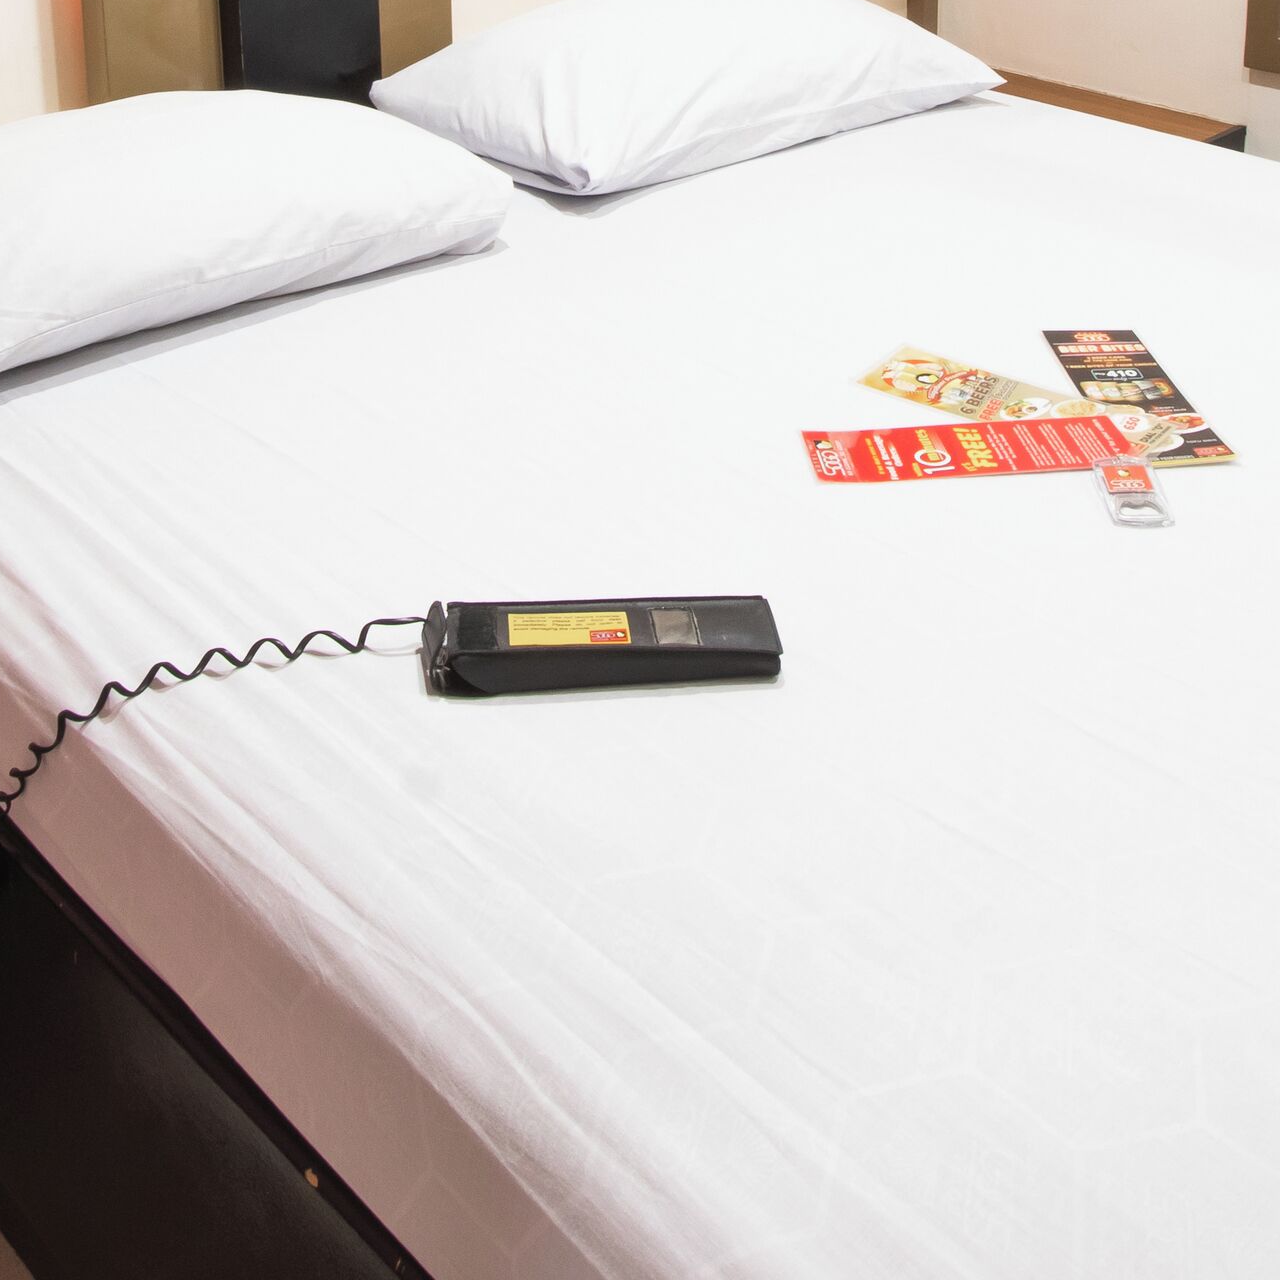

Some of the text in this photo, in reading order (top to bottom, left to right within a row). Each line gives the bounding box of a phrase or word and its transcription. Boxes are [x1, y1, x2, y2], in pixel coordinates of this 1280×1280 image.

[1058, 344, 1146, 353] BEER BITES
[1106, 369, 1138, 378] 410
[960, 375, 998, 415] 6 BEERS
[978, 399, 1002, 421] FREE
[1124, 417, 1140, 430] 650
[952, 427, 998, 468] FREE!
[816, 449, 846, 476] SOGO
[914, 449, 956, 475] 10
